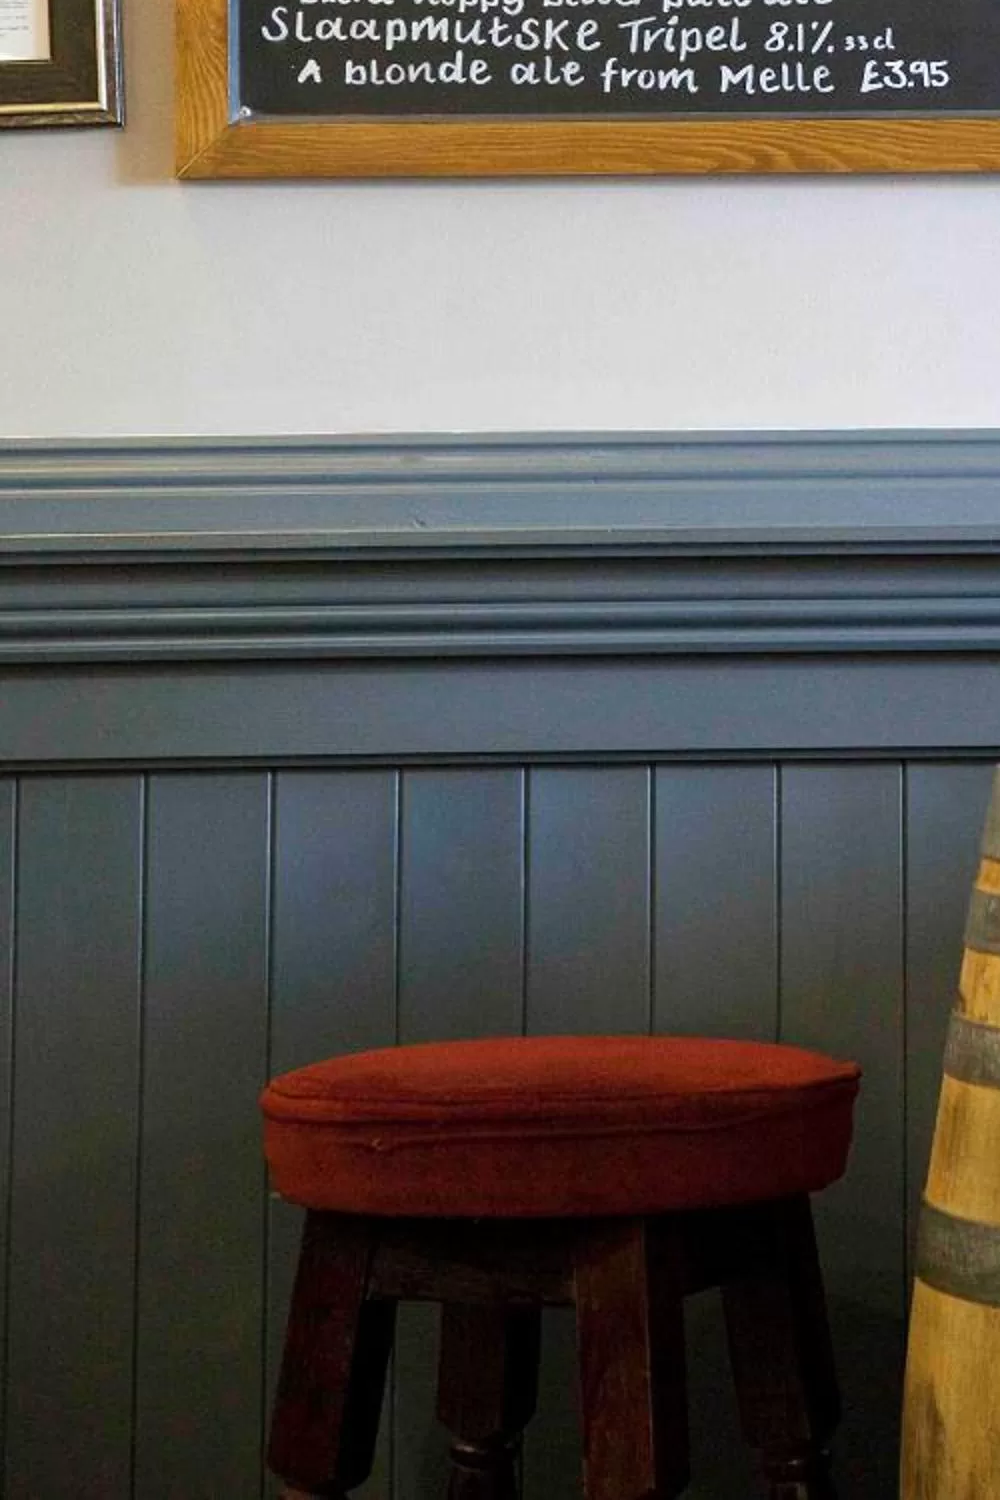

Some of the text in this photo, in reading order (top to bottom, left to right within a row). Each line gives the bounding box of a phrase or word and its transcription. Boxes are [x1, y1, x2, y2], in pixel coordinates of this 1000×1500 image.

[618, 15, 747, 62] Tripel
[764, 20, 834, 54] 8.1%
[345, 50, 950, 94] blonde Melle £3.95
